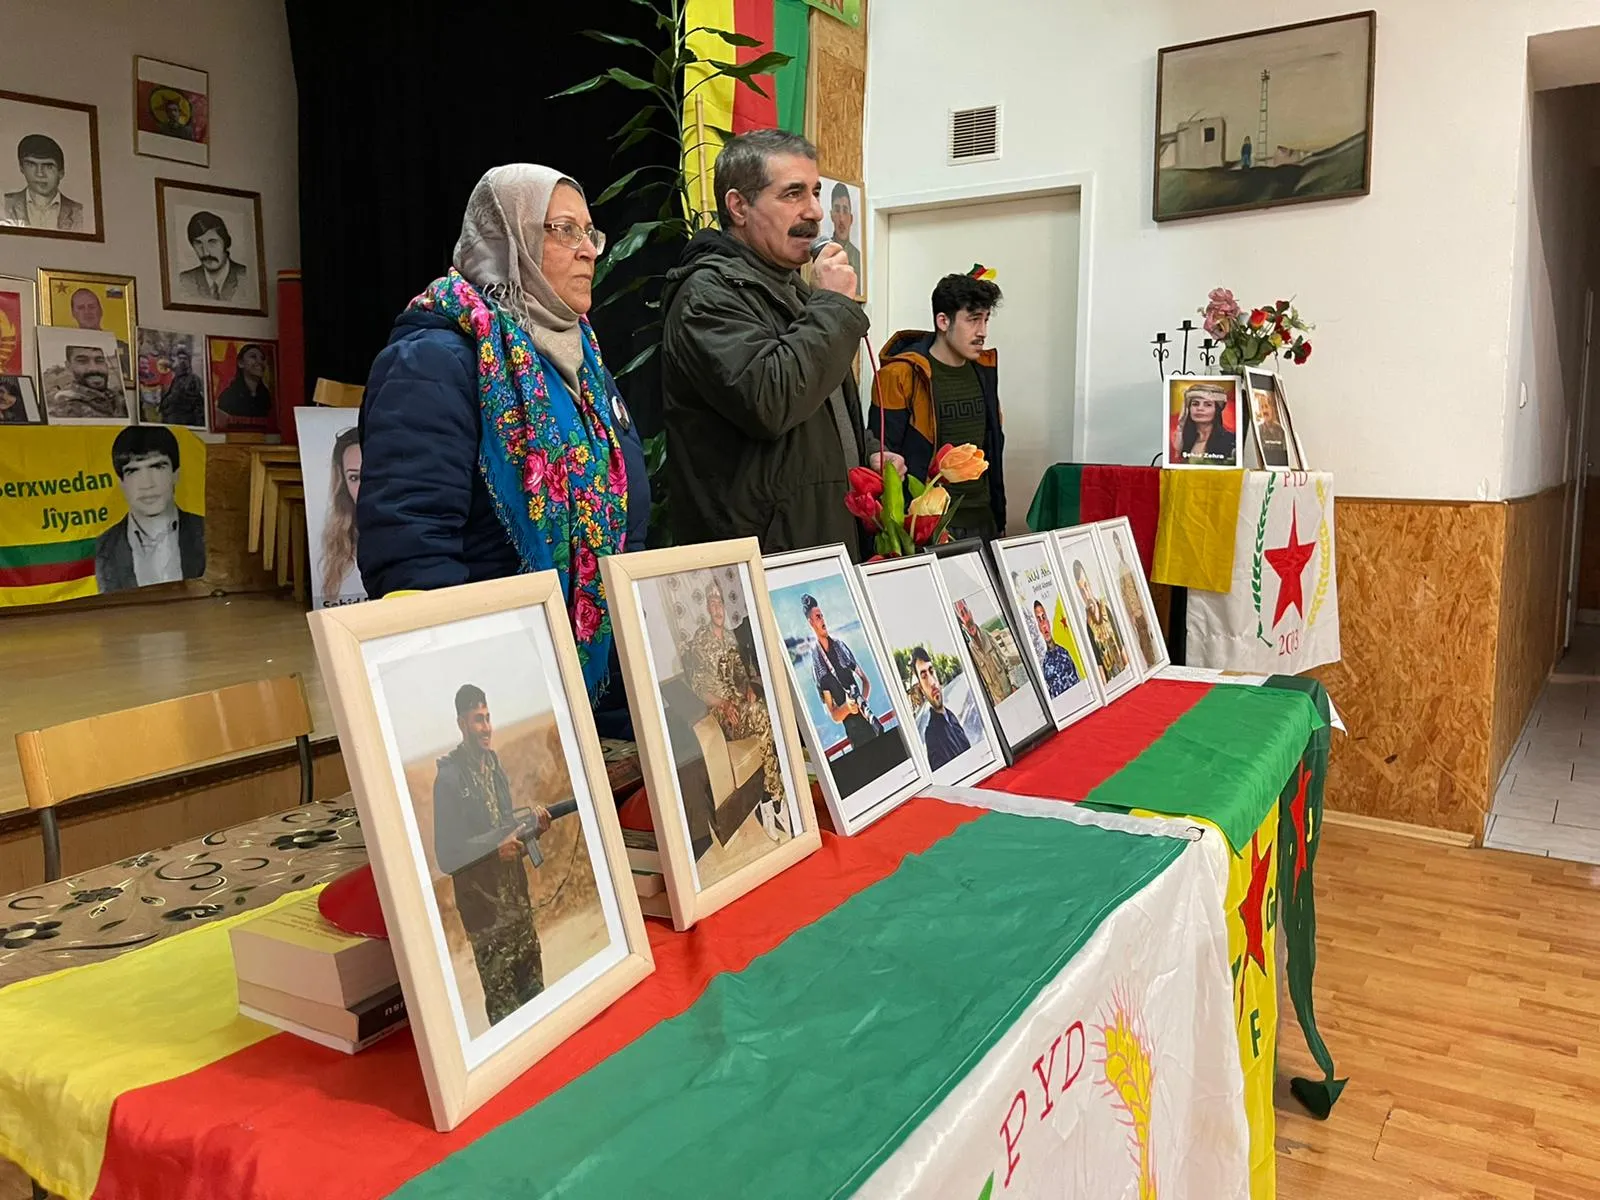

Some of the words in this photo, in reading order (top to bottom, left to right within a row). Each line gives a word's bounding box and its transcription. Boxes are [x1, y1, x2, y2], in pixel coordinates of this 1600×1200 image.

[0, 470, 112, 498] erxwedan
[41, 506, 108, 533] Jîyane
[1000, 1020, 1085, 1189] PYD
